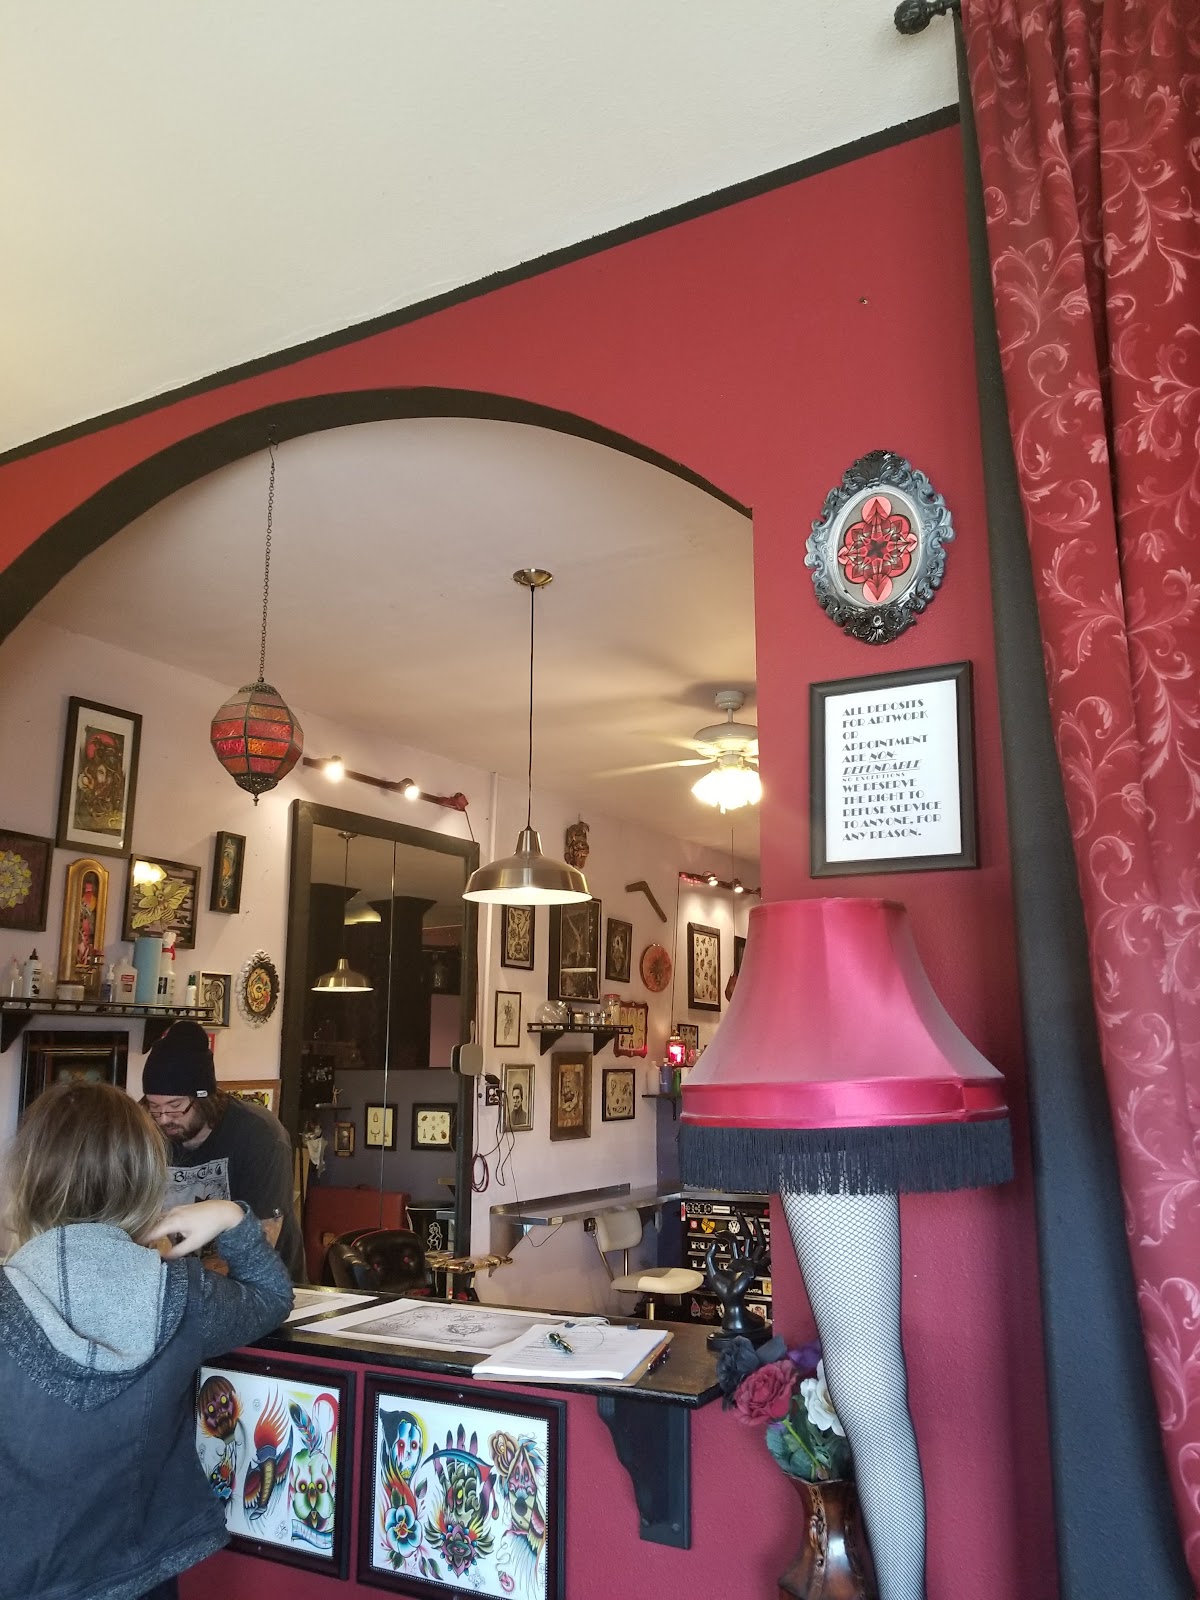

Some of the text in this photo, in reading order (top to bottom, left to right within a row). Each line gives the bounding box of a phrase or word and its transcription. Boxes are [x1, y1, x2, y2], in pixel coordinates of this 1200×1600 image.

[842, 699, 924, 716] ALL DEPOSITS
[843, 710, 928, 728] FOR ARTWORK
[842, 734, 928, 751] APPOINTMENT
[843, 731, 858, 740] OR
[842, 754, 866, 763] ARE
[843, 759, 922, 775] REFUNDABLE
[856, 772, 905, 781] EXCEPTIONS
[843, 778, 918, 792] WE RESERVE
[843, 790, 924, 804] THE RIGHT TO
[843, 801, 942, 817] REFUSE SERVICE
[843, 820, 858, 828] TO
[917, 814, 941, 823] FOR
[842, 829, 921, 841] ANY REASON.
